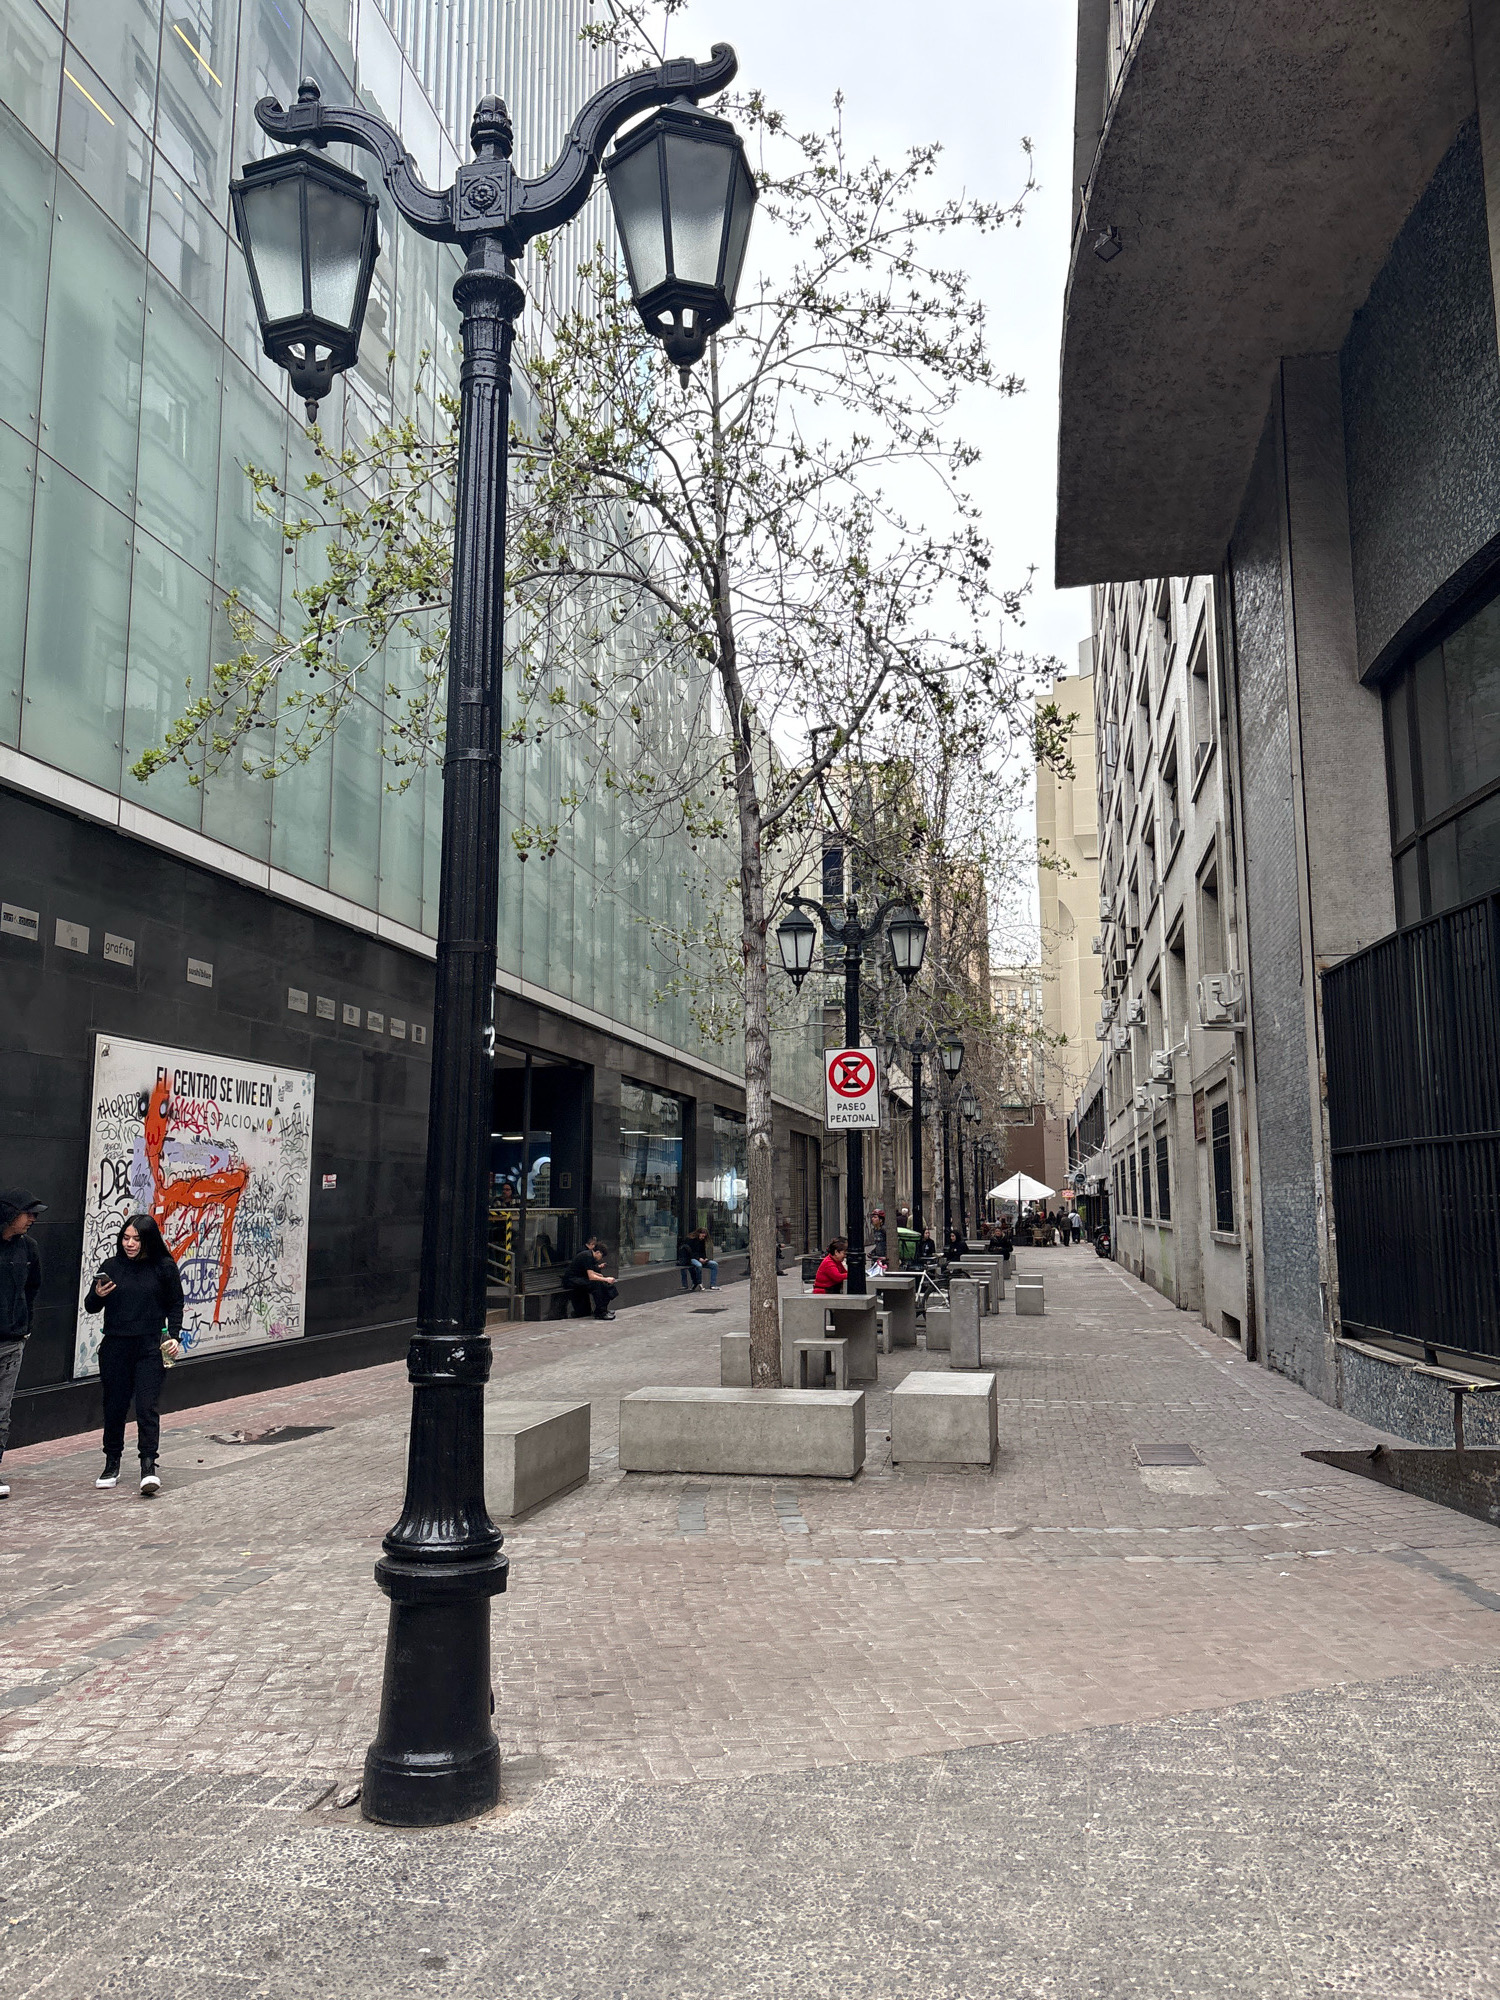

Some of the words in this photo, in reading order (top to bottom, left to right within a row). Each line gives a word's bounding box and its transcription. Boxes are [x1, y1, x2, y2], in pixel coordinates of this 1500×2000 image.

[105, 942, 134, 958] grafito
[156, 1066, 170, 1095] EL
[173, 1069, 217, 1101] CENTRO
[220, 1076, 233, 1103] SE
[236, 1079, 258, 1106] VIVE
[260, 1083, 273, 1108] EN
[837, 1102, 866, 1111] PASEO
[203, 1110, 252, 1130] ESPACIO
[830, 1114, 876, 1123] PEATONAL
